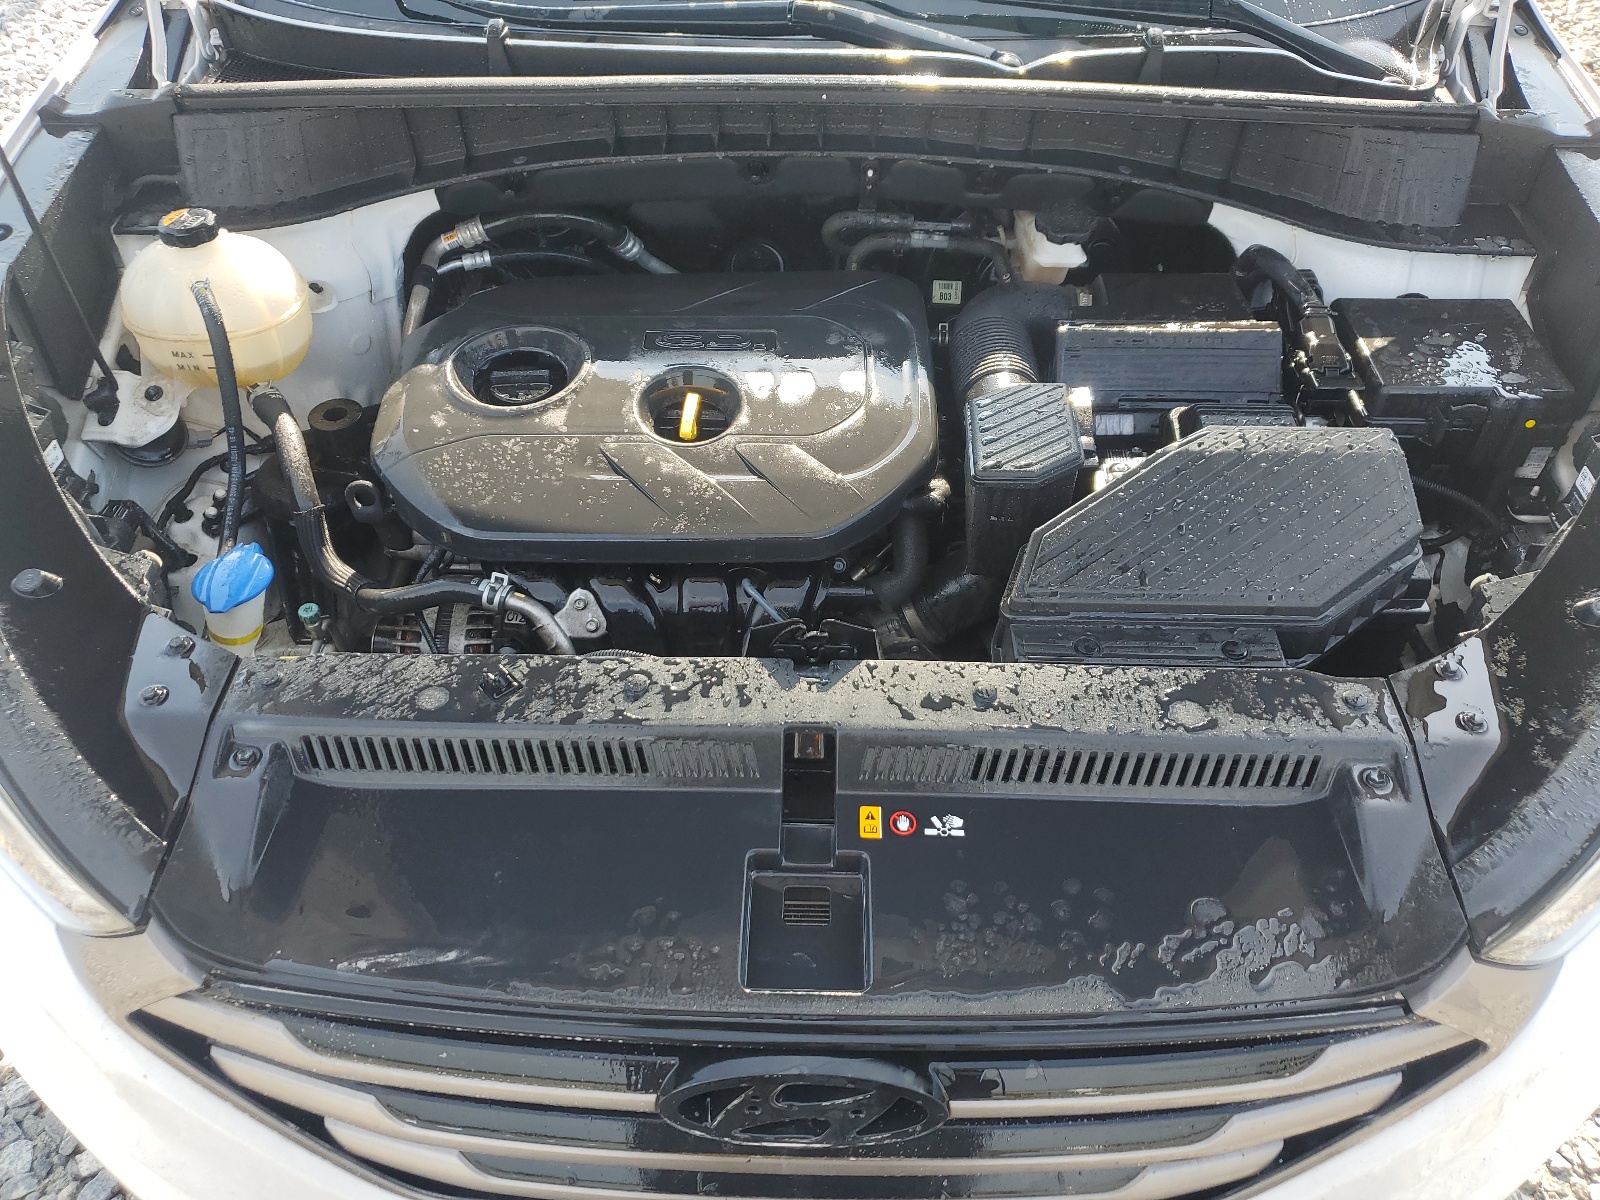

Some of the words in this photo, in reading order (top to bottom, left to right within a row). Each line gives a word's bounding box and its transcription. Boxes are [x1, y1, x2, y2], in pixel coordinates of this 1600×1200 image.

[939, 291, 952, 301] B03
[171, 350, 195, 359] MAX
[176, 363, 201, 371] MIN
